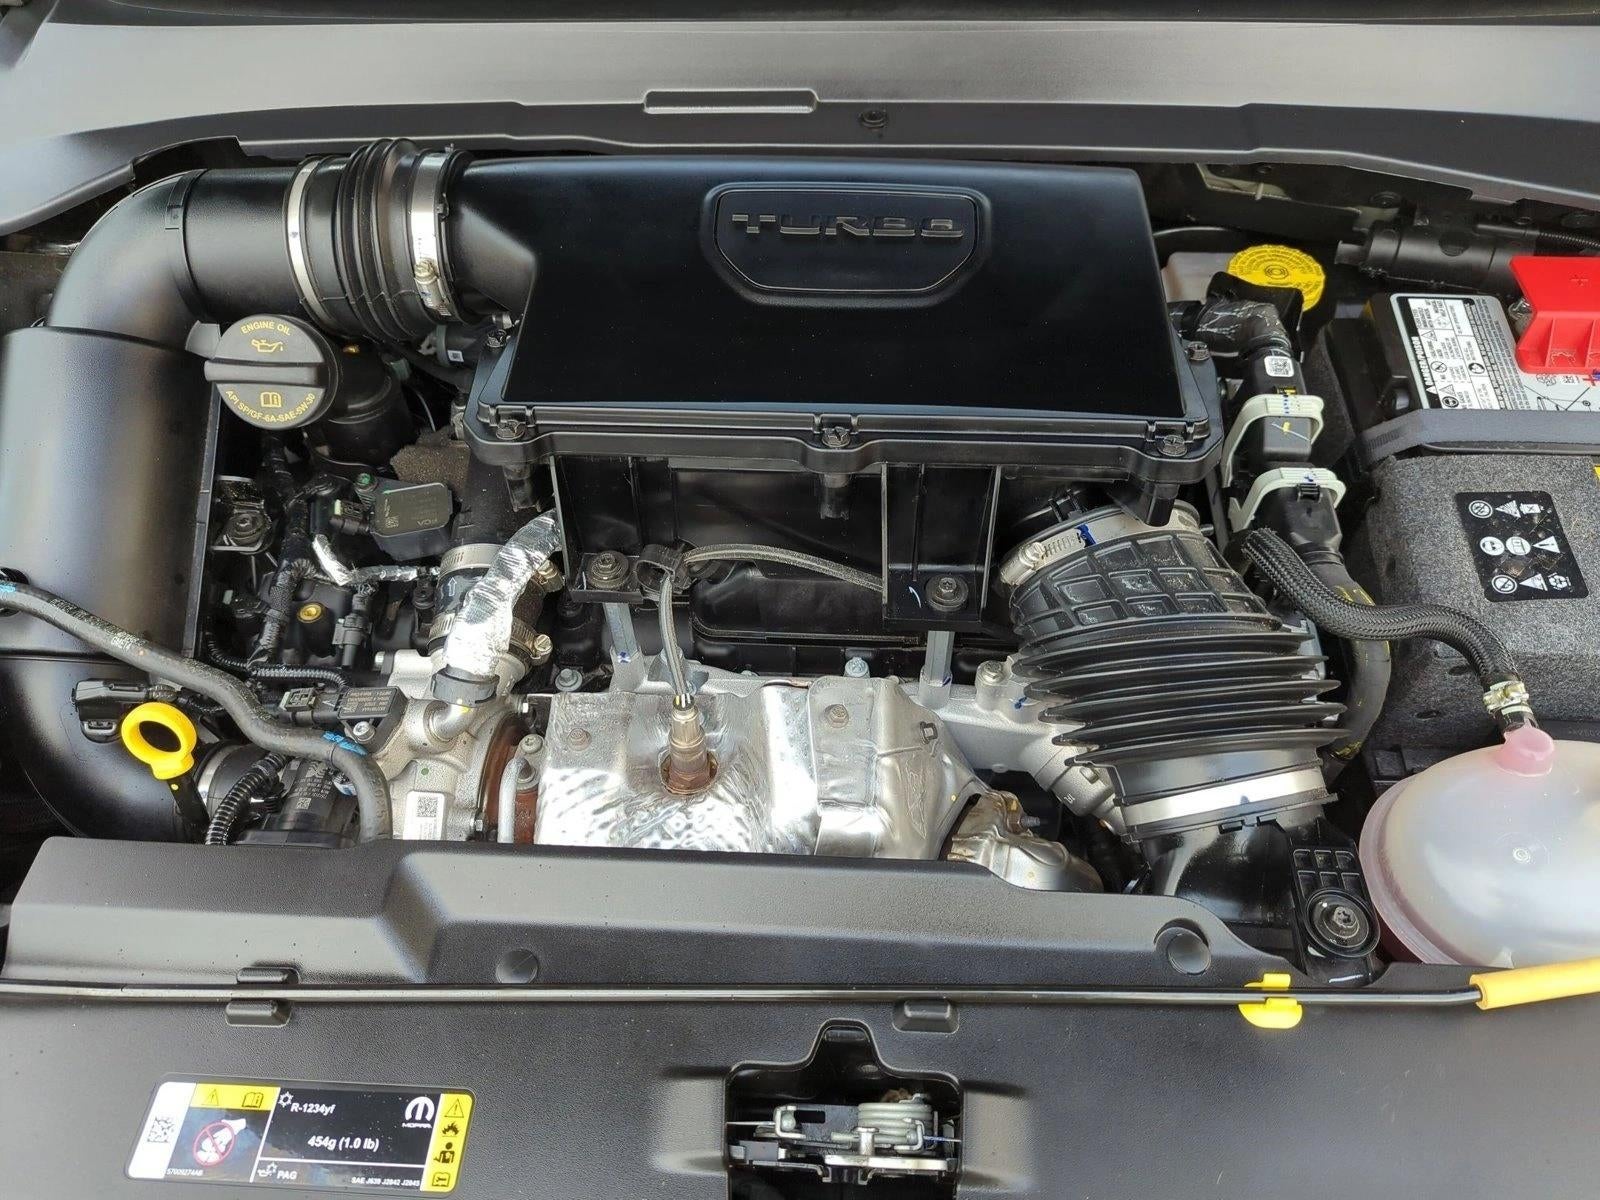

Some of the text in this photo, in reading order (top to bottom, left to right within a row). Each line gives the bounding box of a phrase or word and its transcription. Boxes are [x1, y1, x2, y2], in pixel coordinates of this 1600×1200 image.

[731, 213, 963, 238] TURBO
[241, 321, 291, 336] ENGINE OIL
[225, 390, 239, 405] API
[290, 1102, 336, 1116] R-1234yf
[307, 1135, 380, 1153] 454g (1.0 lb)
[277, 1170, 298, 1180] PAG
[351, 1176, 366, 1184] SAE
